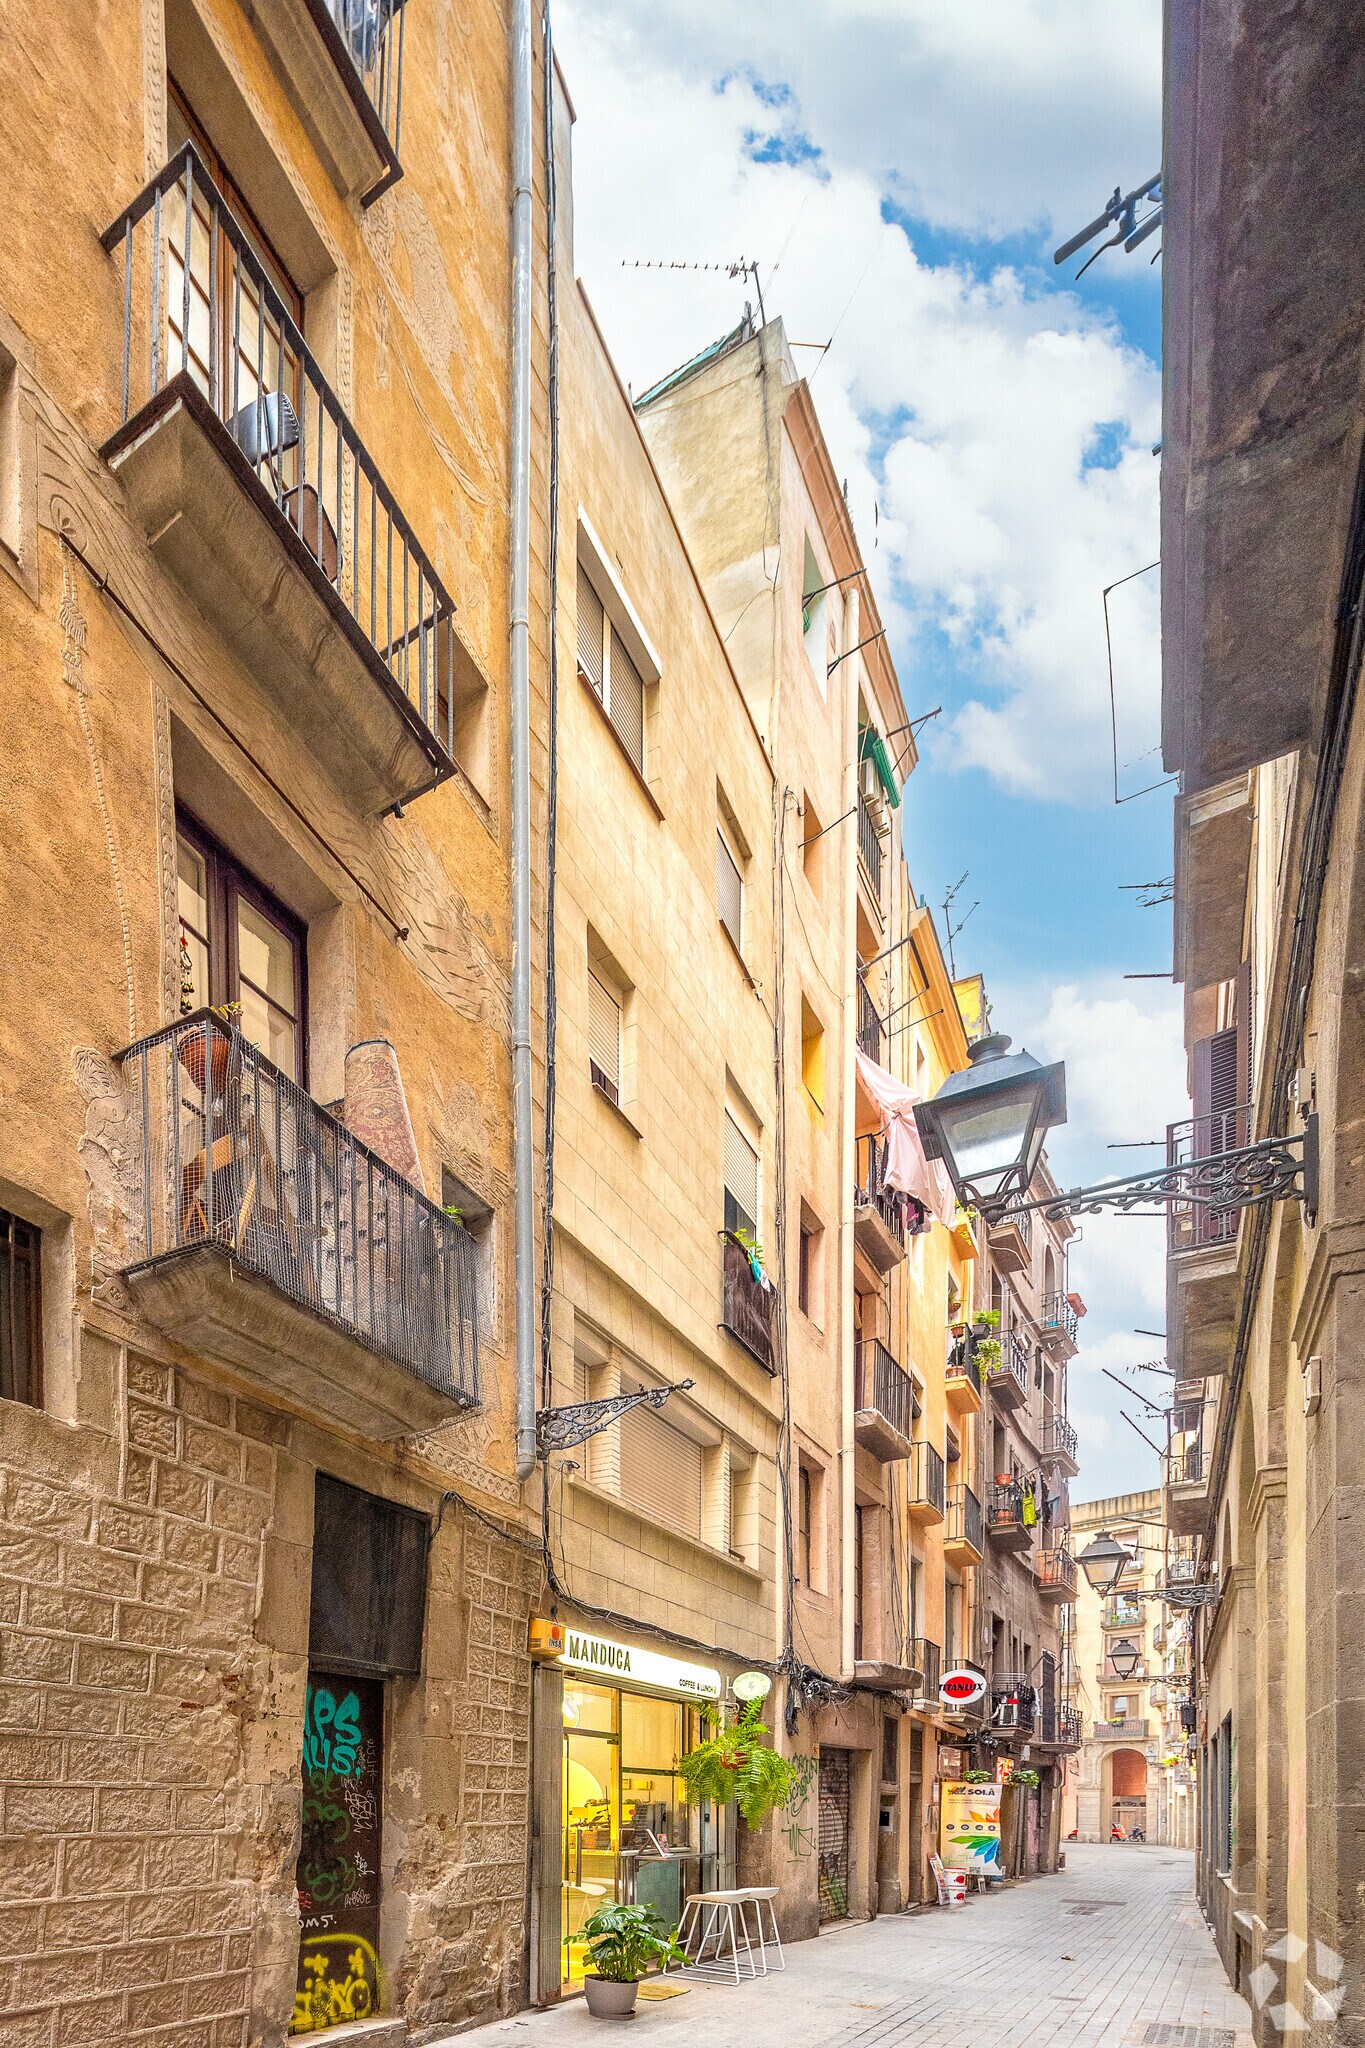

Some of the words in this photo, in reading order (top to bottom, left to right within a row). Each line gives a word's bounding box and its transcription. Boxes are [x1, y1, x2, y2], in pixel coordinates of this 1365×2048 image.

[569, 1634, 631, 1672] MANDUCA
[679, 1678, 696, 1690] COFFEE
[701, 1683, 713, 1692] LUNCH
[938, 1682, 984, 1691] TITANLUX
